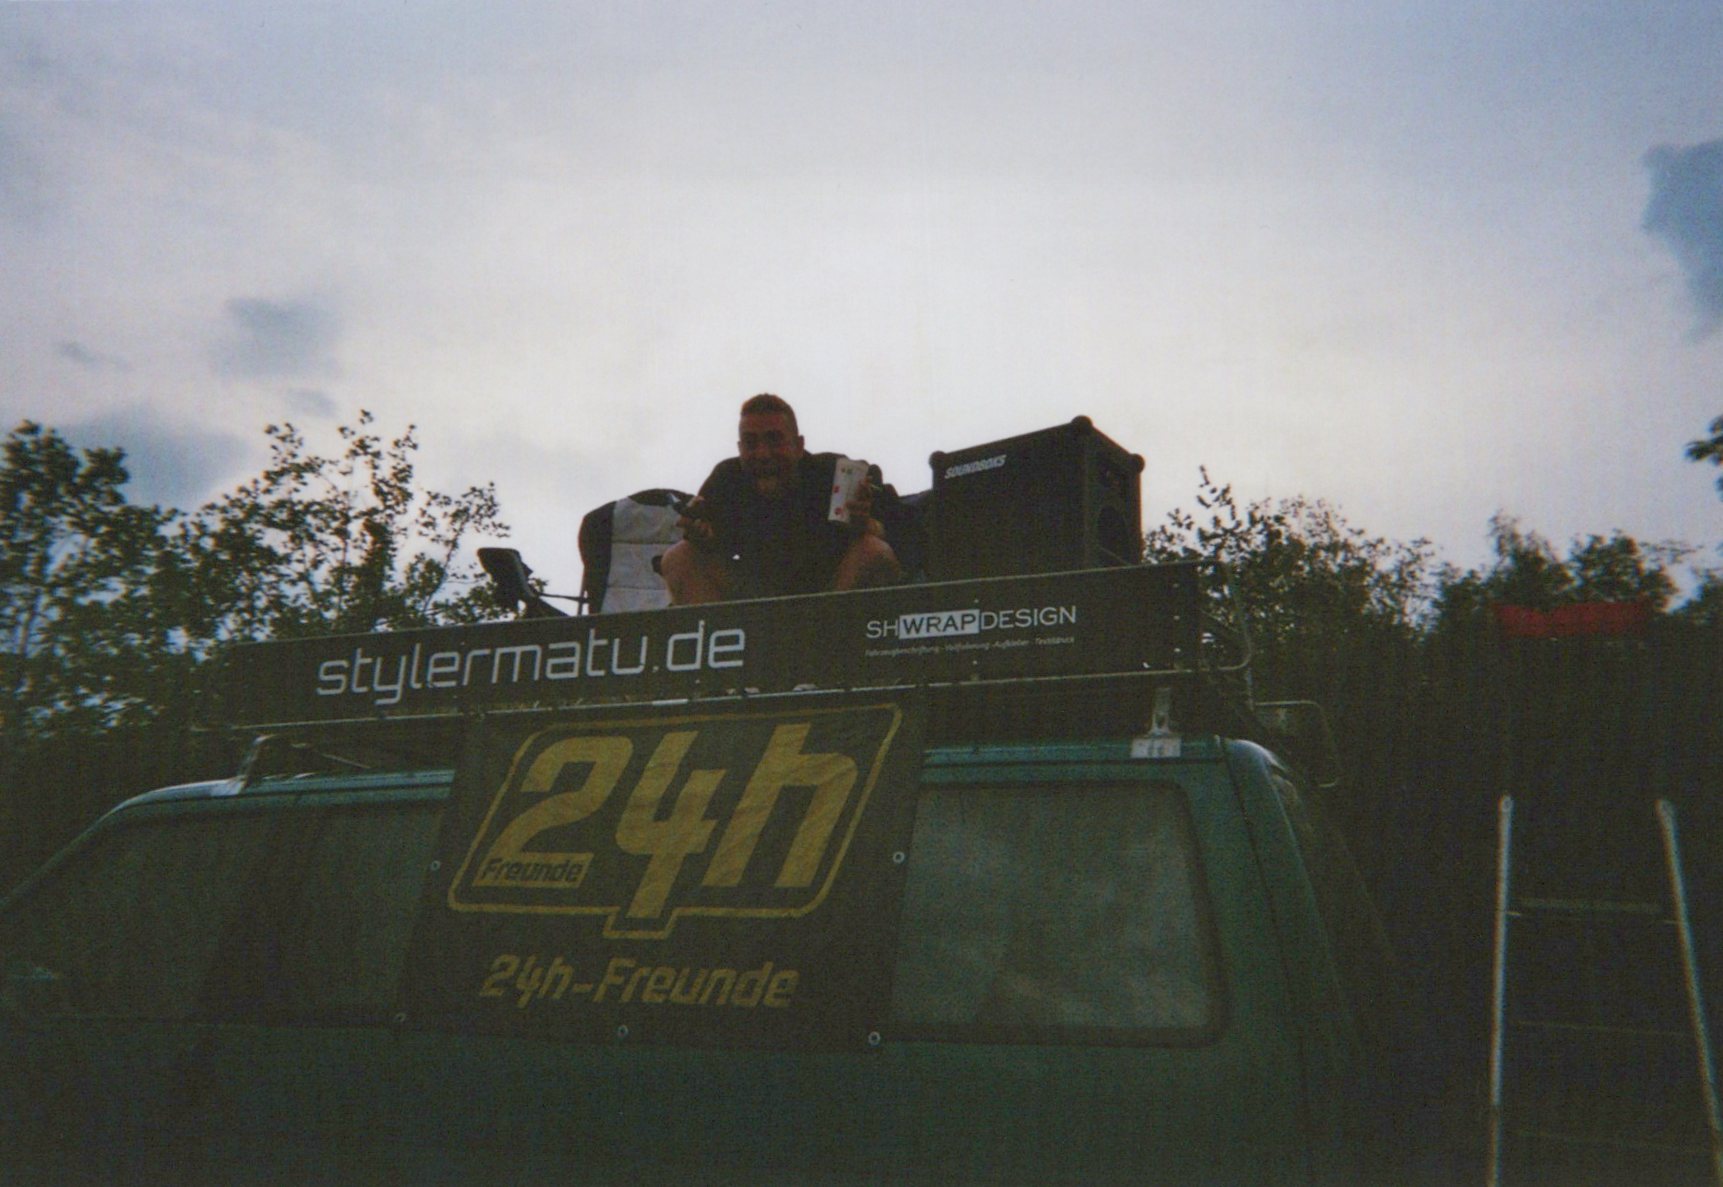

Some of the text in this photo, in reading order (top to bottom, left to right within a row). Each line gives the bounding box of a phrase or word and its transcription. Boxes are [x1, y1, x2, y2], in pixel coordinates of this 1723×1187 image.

[316, 620, 746, 706] stylermatu.de
[473, 723, 858, 919] 24h
[479, 858, 581, 882] Freunde
[480, 954, 799, 1009] 24h-Freunde
